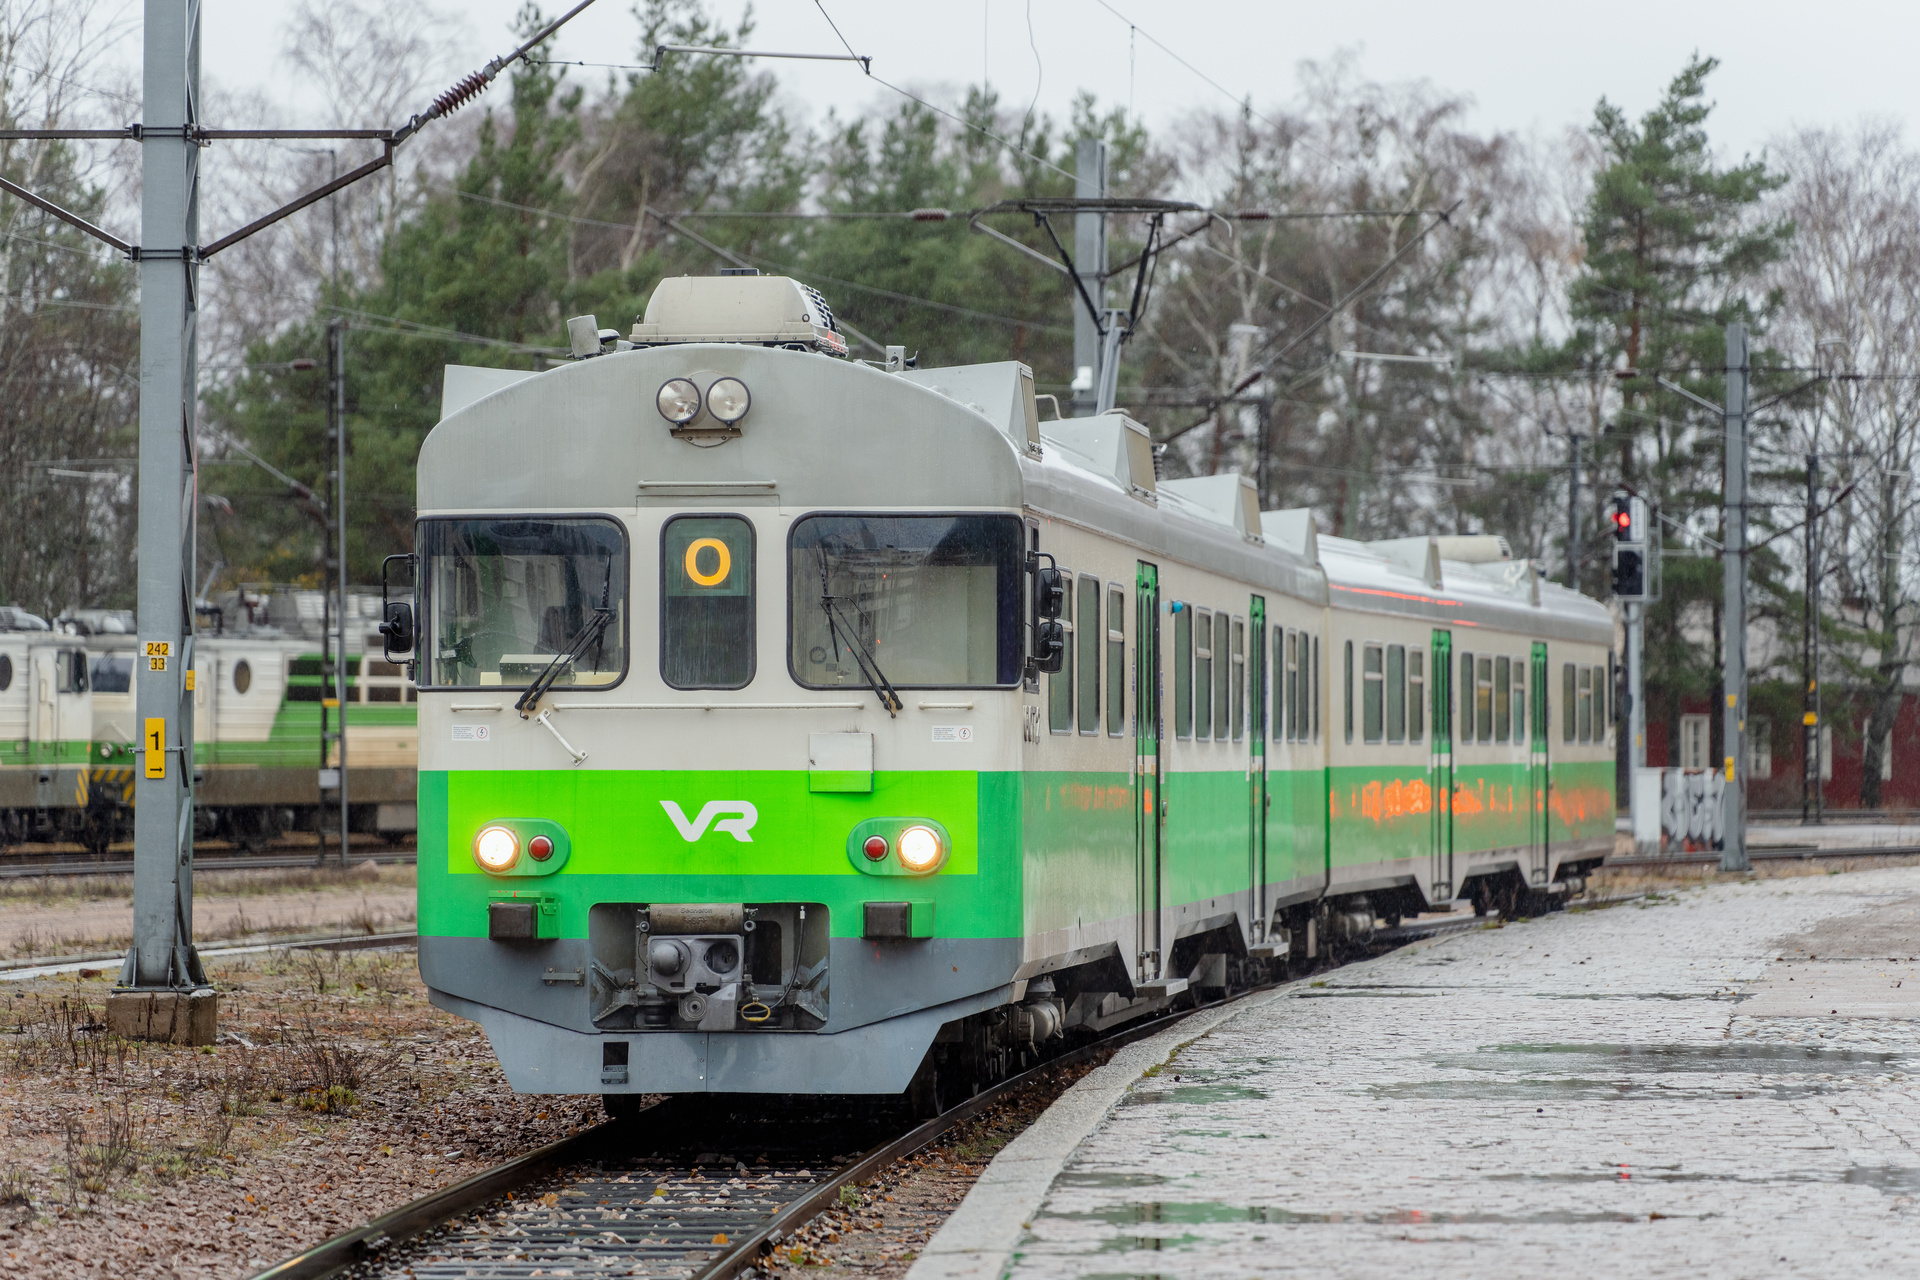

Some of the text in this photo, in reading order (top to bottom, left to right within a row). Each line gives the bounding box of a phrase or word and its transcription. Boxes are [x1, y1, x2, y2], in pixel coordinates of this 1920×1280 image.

[685, 538, 731, 586] O
[146, 642, 169, 656] 242
[150, 657, 165, 671] 33
[150, 731, 159, 750] 1
[659, 800, 758, 842] VR
